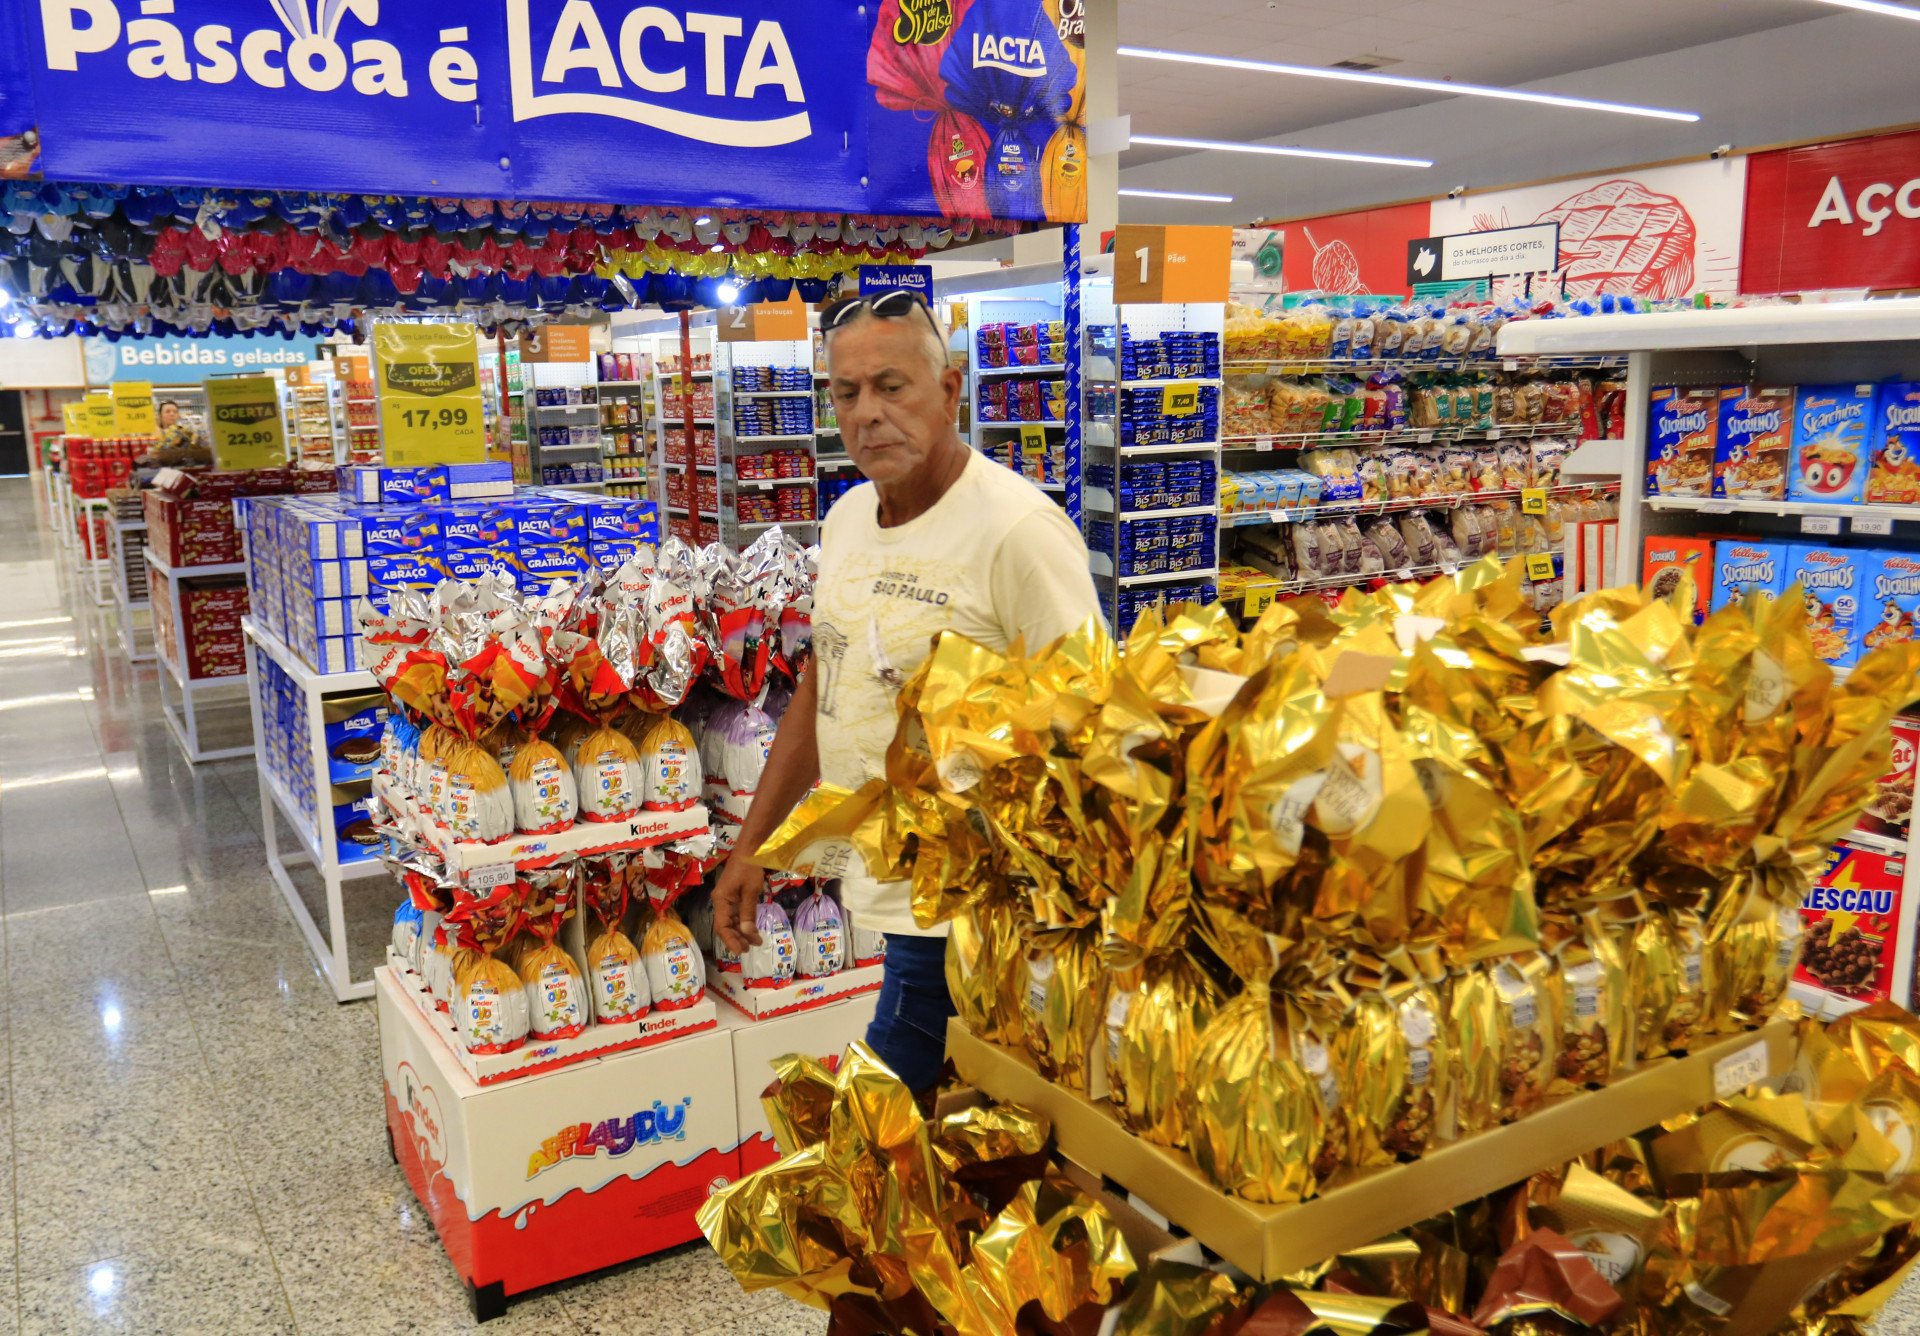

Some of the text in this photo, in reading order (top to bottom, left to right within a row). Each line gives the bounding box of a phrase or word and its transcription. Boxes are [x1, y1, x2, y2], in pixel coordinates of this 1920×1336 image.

[914, 6, 952, 44] Valsa
[973, 33, 1047, 77] LACTA
[41, 0, 812, 147] Páscoa é LACTA
[1452, 240, 1545, 258] OS MELHORES CORTES,
[1135, 247, 1149, 283] 1
[1167, 253, 1186, 263] Pães
[1461, 257, 1490, 265] churrasco
[865, 275, 890, 286] Páscoa
[899, 273, 926, 288] LACTA
[730, 306, 746, 329] 2
[121, 343, 306, 368] Bebidas geladas
[340, 362, 349, 374] 5
[408, 366, 452, 375] OFERTA
[288, 371, 298, 382] 6
[217, 405, 275, 420] OFERTA
[402, 409, 468, 430] 17,99
[1659, 411, 1708, 439] SUCRILHOS
[1727, 410, 1781, 440] SUCRILHOS
[227, 431, 273, 447] 22,90
[1687, 435, 1710, 448] MIX
[1758, 436, 1783, 449] MIX
[383, 479, 414, 494] LACTA
[518, 520, 551, 534] LACTA
[593, 515, 623, 529] LACTA
[1860, 522, 1882, 532] 19,90
[366, 528, 402, 544] LACTA
[445, 524, 478, 538] LACTA
[447, 553, 465, 561] LACTA
[520, 547, 538, 556] LACTA
[600, 552, 637, 564] GRATID
[1729, 547, 1769, 560] Kellogg's
[1804, 550, 1849, 565] Kellogg's
[370, 559, 388, 567] LACTA
[454, 560, 506, 574] GRATIDÃO
[528, 554, 576, 567] GRATIDÃO
[382, 568, 428, 580] ABRAÇO
[1721, 561, 1775, 586] SUCRILHOS
[1795, 565, 1855, 590] SUCRILHOS
[896, 584, 949, 606] PAULO
[654, 593, 689, 615] Kinder
[344, 718, 374, 731] LACTA
[630, 822, 669, 836] Kinder
[477, 871, 509, 885] 105,90
[638, 1016, 677, 1034] Kinder
[525, 1098, 689, 1182] APPLAYDU
